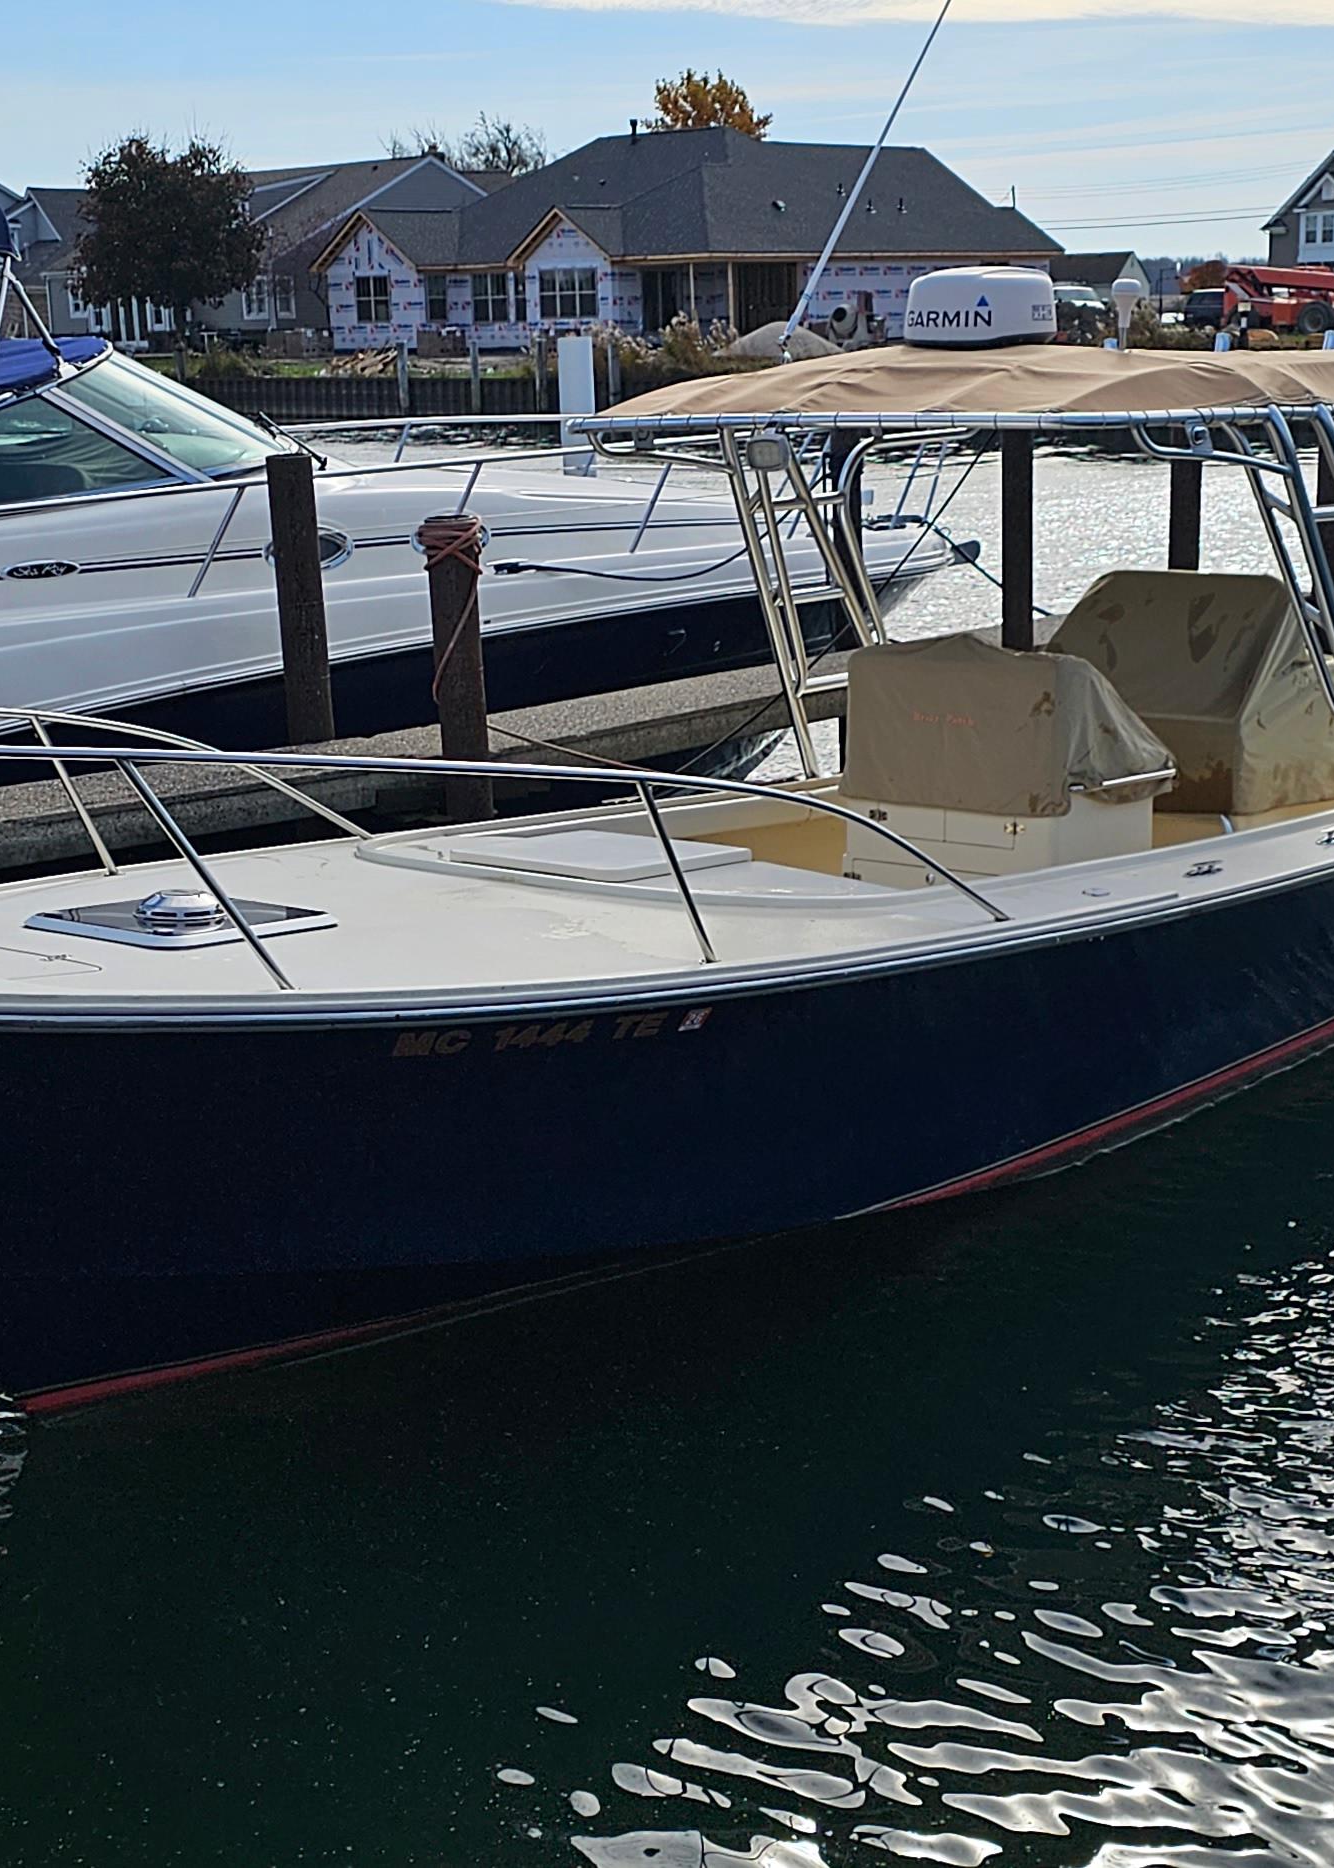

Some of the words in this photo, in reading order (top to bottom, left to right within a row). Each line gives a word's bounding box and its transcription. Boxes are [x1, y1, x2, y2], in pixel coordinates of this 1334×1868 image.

[907, 309, 992, 328] GARMIN
[392, 1029, 473, 1058] MC
[493, 1018, 596, 1053] 1444
[612, 1011, 669, 1041] TE
